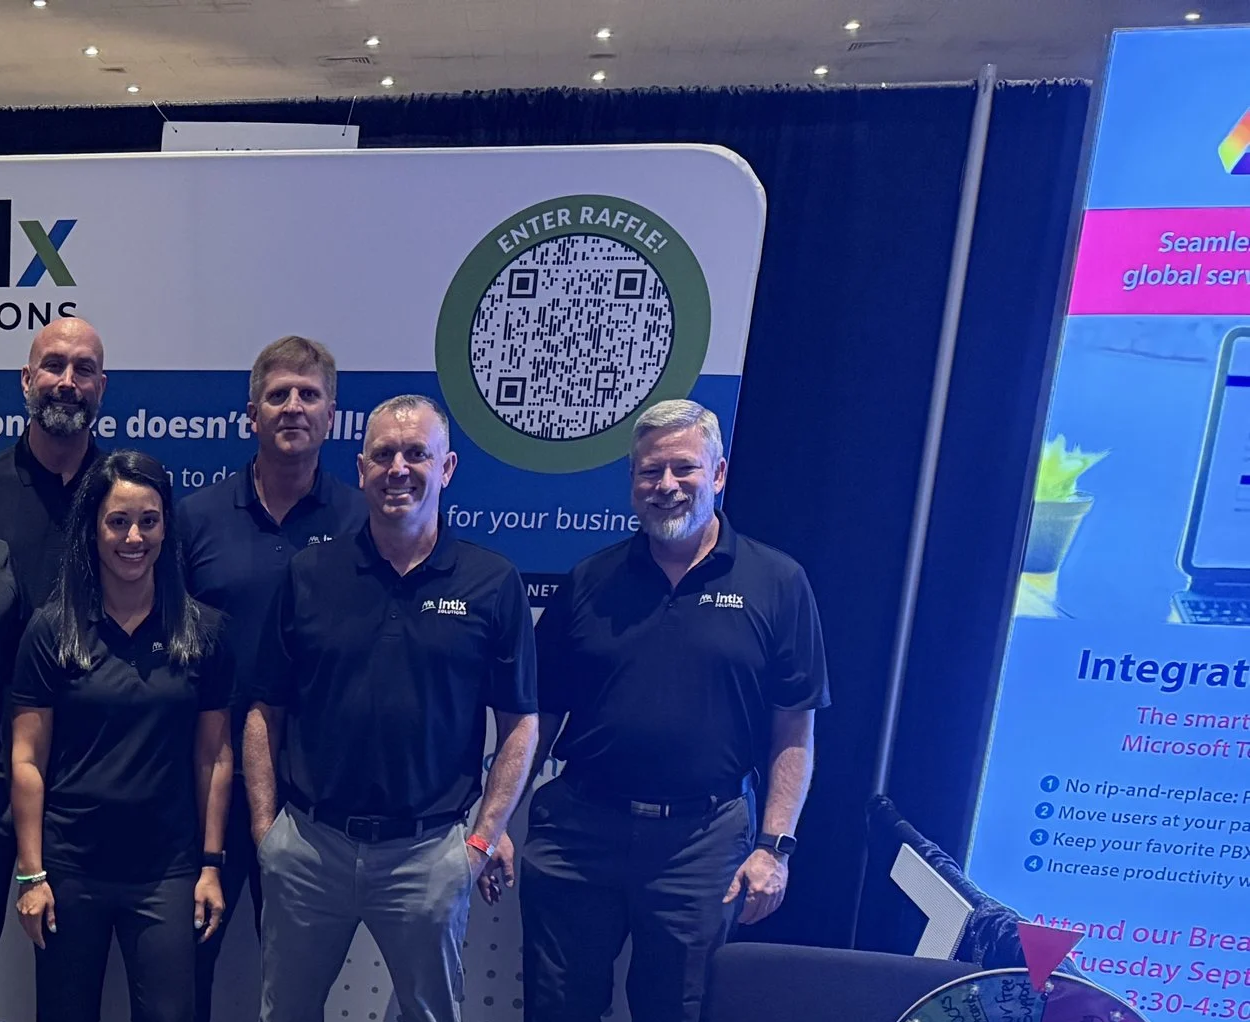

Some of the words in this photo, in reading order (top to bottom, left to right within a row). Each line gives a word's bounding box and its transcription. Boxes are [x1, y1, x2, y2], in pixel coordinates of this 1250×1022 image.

[497, 208, 572, 254] ENTER
[580, 206, 668, 254] RAFFLE!
[1158, 231, 1250, 253] Seamle
[1123, 264, 1202, 291] global
[182, 468, 205, 488] to
[446, 504, 484, 528] for
[487, 510, 549, 534] your
[556, 506, 641, 532] busine
[1078, 649, 1250, 693] Integrat
[1138, 706, 1178, 726] The
[1122, 734, 1230, 758] Microsoft
[1066, 778, 1090, 794] No
[1095, 781, 1239, 804] rip-and-replace:
[1058, 806, 1107, 822] Move
[1112, 810, 1158, 826] users
[1162, 814, 1180, 828] at
[1182, 817, 1226, 832] your
[1053, 832, 1097, 851] Keep
[1100, 837, 1142, 852] your
[1146, 838, 1215, 857] favorite
[1047, 858, 1120, 878] Increase
[1123, 866, 1235, 890] productivity
[1132, 927, 1182, 946] our
[1189, 926, 1250, 952] Brea
